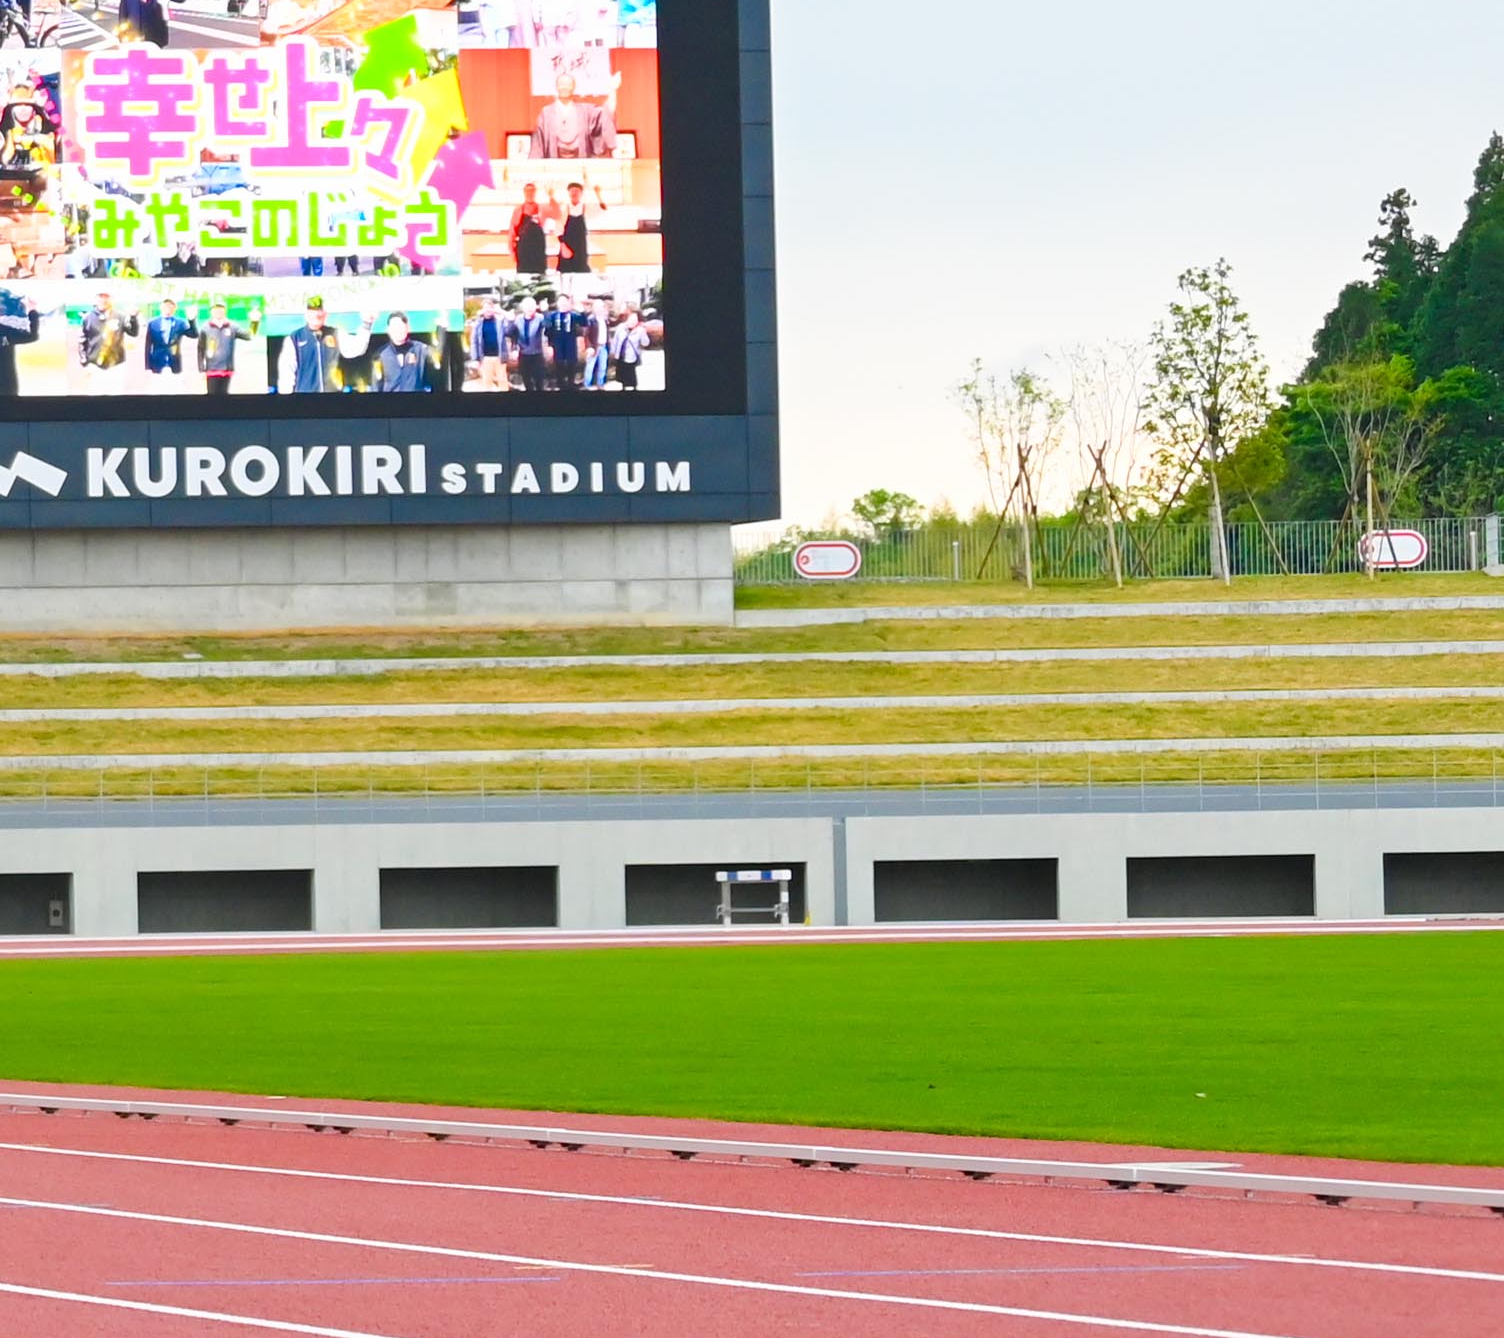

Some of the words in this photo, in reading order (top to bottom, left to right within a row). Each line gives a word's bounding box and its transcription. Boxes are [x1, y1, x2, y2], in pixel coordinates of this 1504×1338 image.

[84, 43, 412, 177] 幸せ上々
[93, 191, 447, 249] みやこのじょう
[88, 444, 426, 498] KUROKIRI
[441, 461, 691, 495] STADIUM
